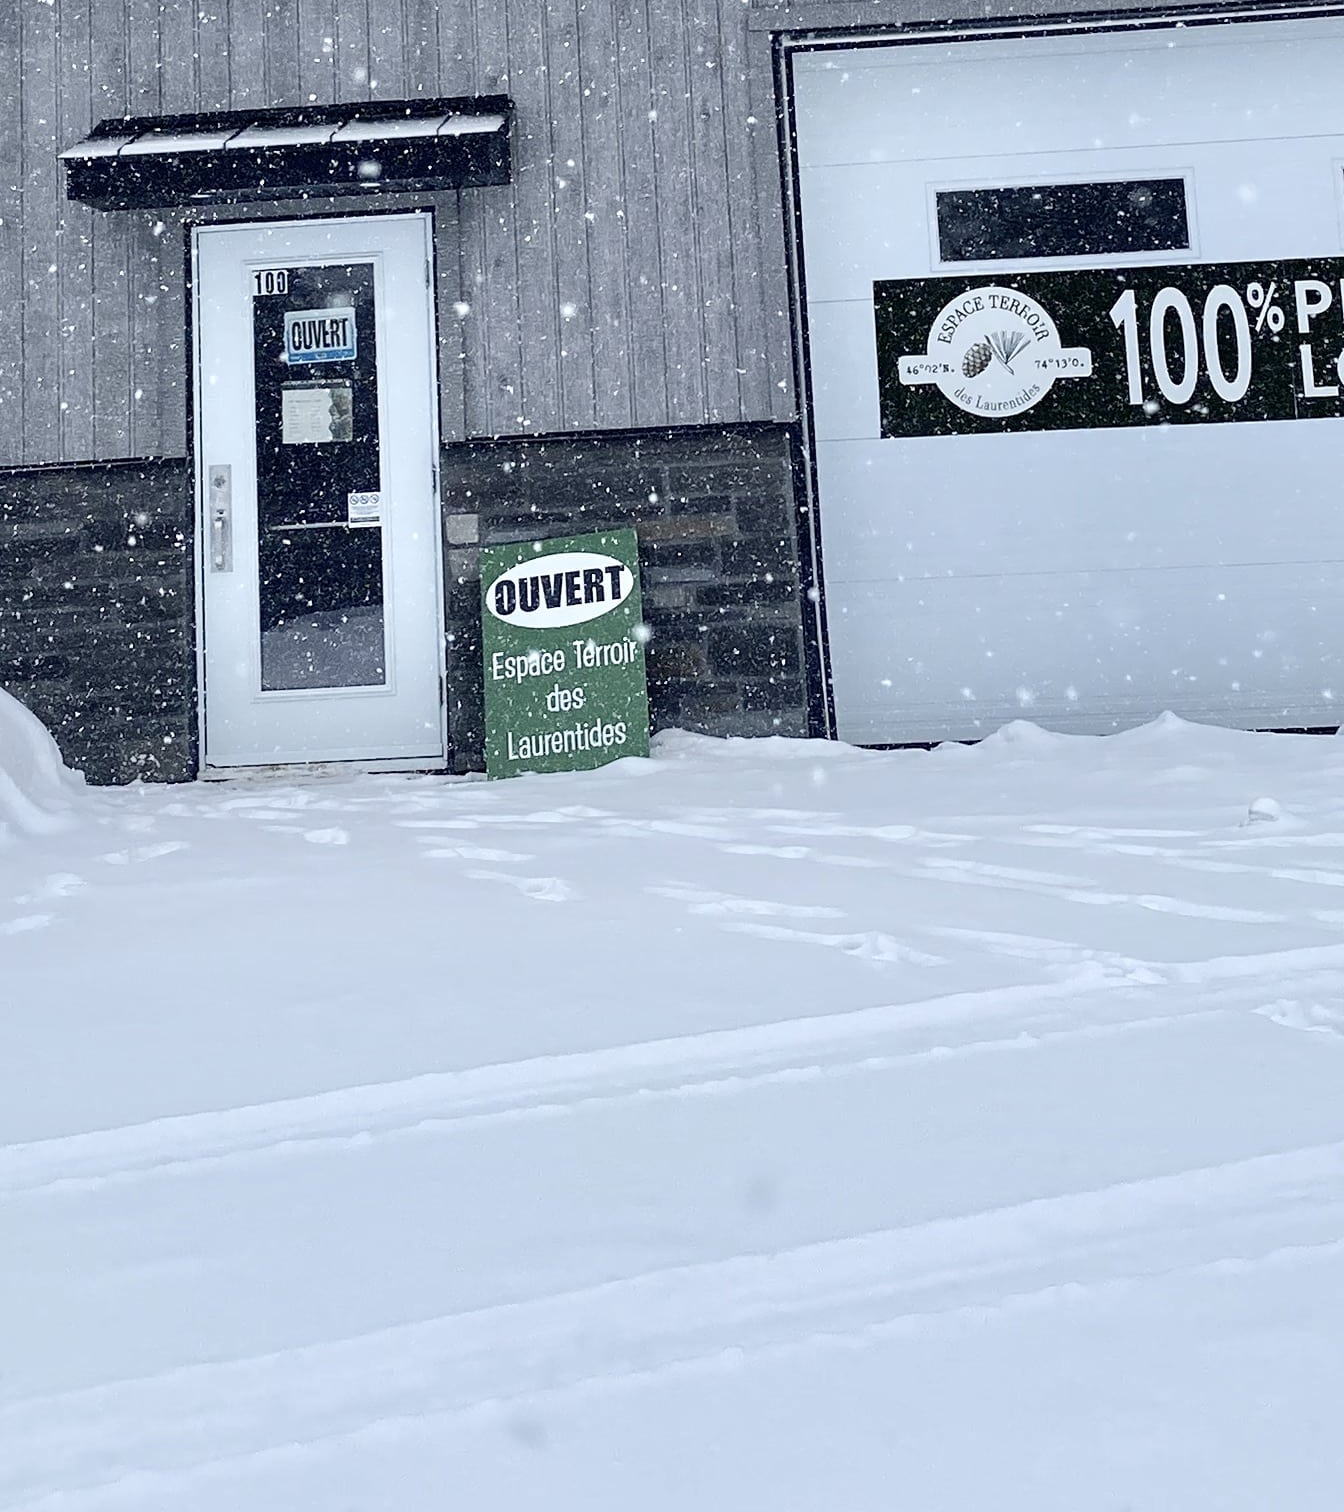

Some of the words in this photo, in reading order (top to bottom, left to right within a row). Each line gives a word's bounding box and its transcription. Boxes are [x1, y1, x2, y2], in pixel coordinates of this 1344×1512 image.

[291, 318, 349, 351] OUVERT
[937, 296, 985, 344] ESPACE
[989, 295, 1049, 342] TERROIR
[1109, 282, 1285, 405] 100%
[954, 387, 972, 405] des
[976, 383, 1040, 411] Laurentides
[495, 565, 624, 615] OUVERT
[492, 649, 565, 683] Espace
[573, 637, 637, 669] Terroir
[547, 684, 584, 712] des
[508, 718, 626, 760] Laurentides
